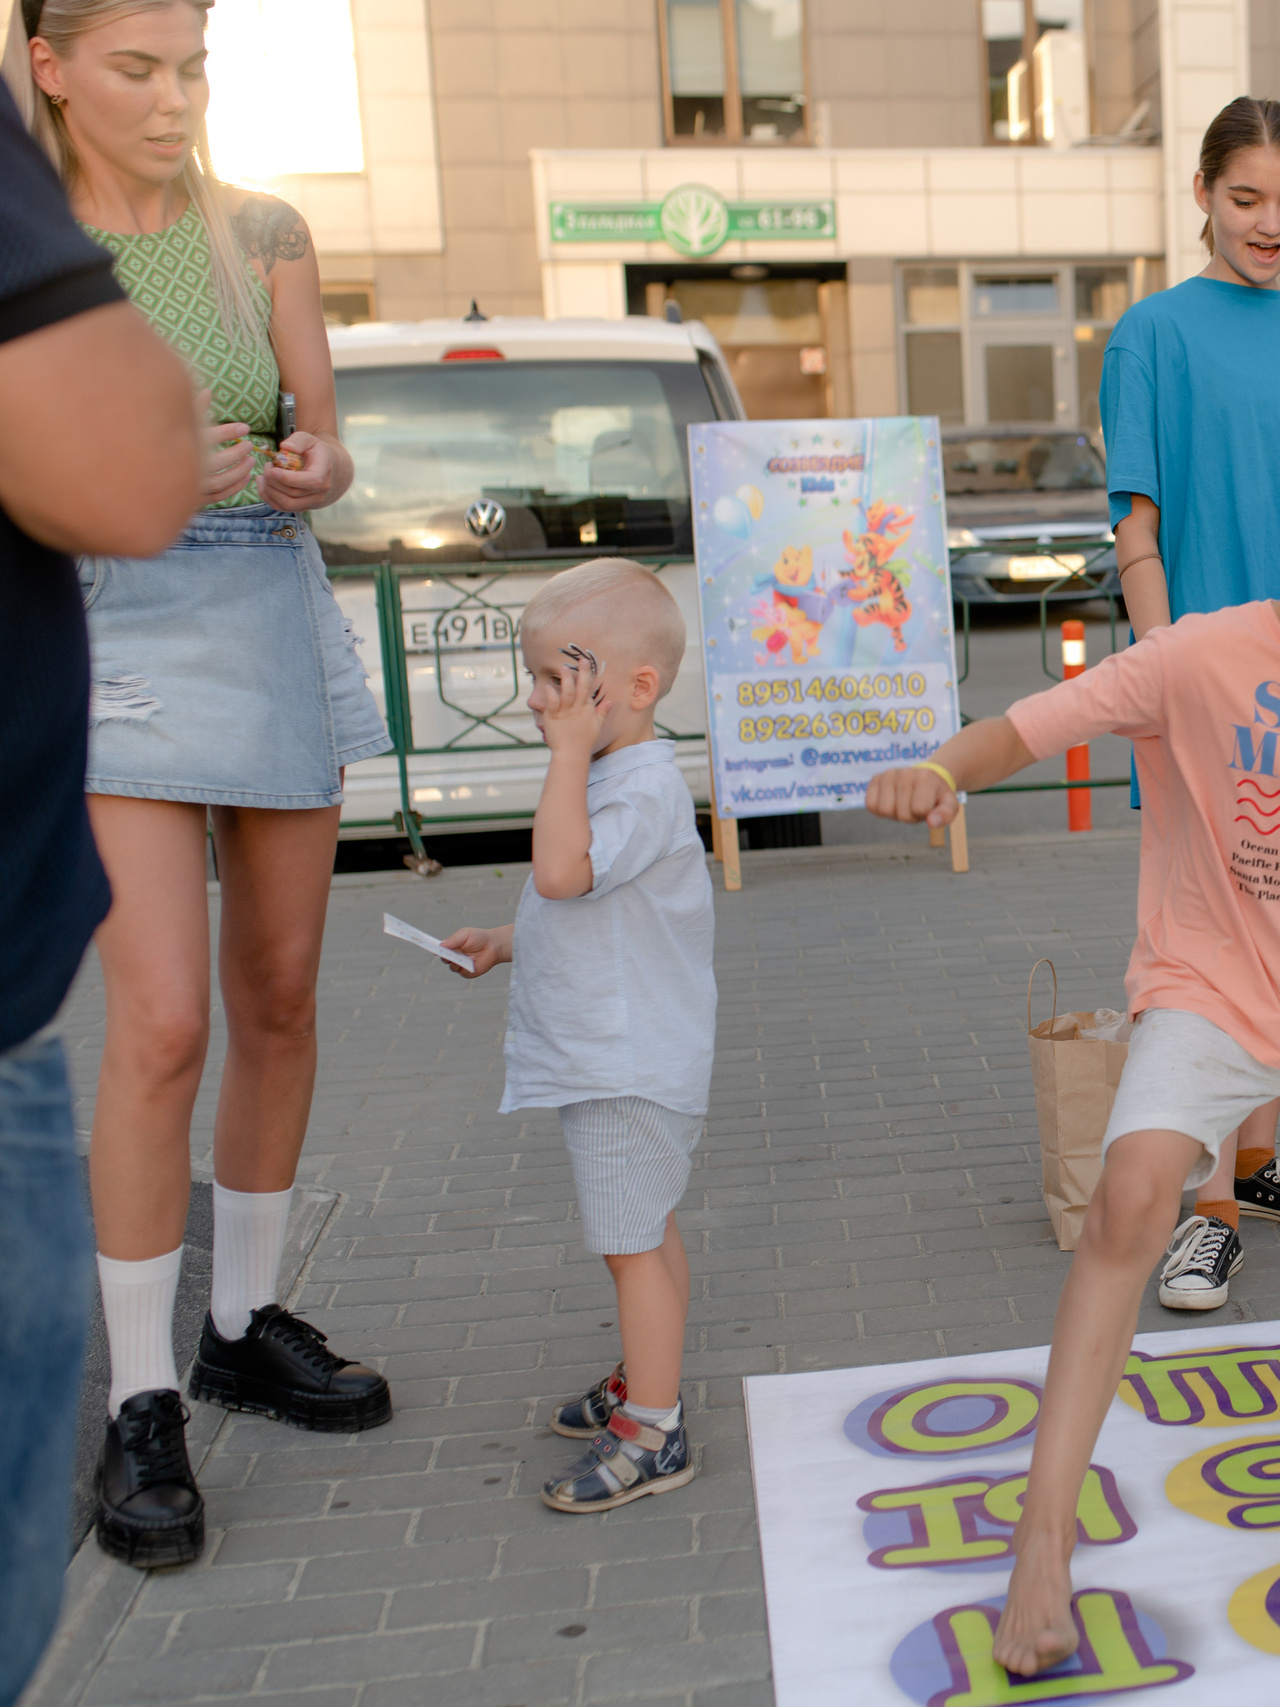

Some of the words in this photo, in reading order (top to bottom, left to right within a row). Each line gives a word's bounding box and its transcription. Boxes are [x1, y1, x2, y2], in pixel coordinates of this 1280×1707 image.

[737, 672, 926, 707] 89514606010
[738, 707, 936, 743] 89226305470
[1241, 839, 1279, 856] Ocean
[1231, 852, 1272, 869] Pacific
[1229, 865, 1260, 884] Santa
[1236, 881, 1256, 896] The
